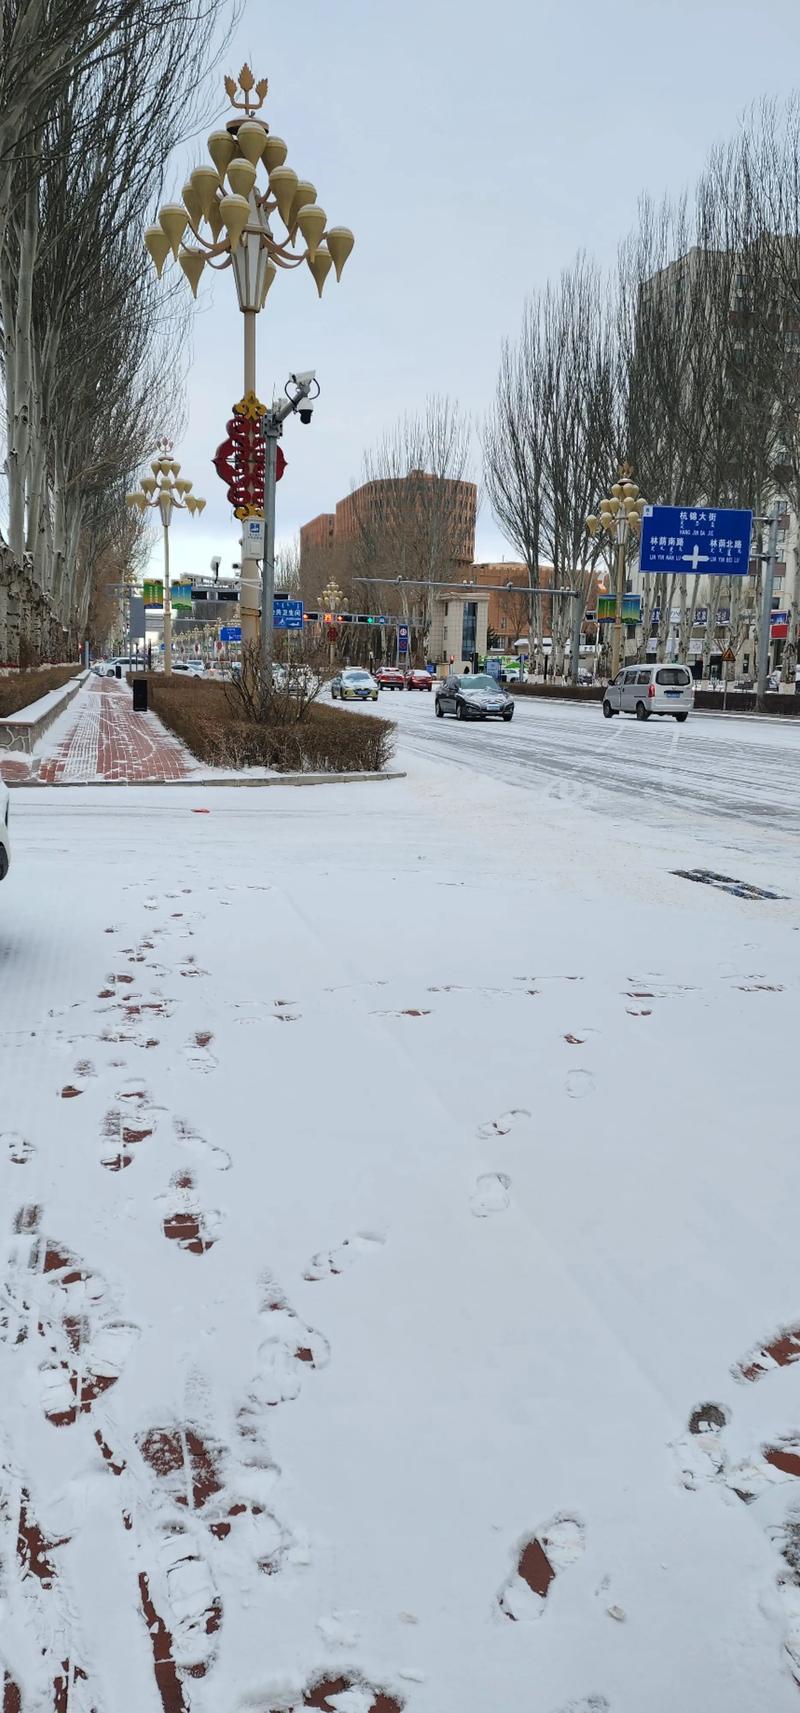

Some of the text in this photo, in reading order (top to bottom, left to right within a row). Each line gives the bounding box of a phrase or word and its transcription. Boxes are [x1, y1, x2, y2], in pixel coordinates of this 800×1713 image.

[680, 511, 717, 521] 杭锦大街
[650, 536, 684, 546] 林荫南路
[710, 539, 742, 549] 林荫北路
